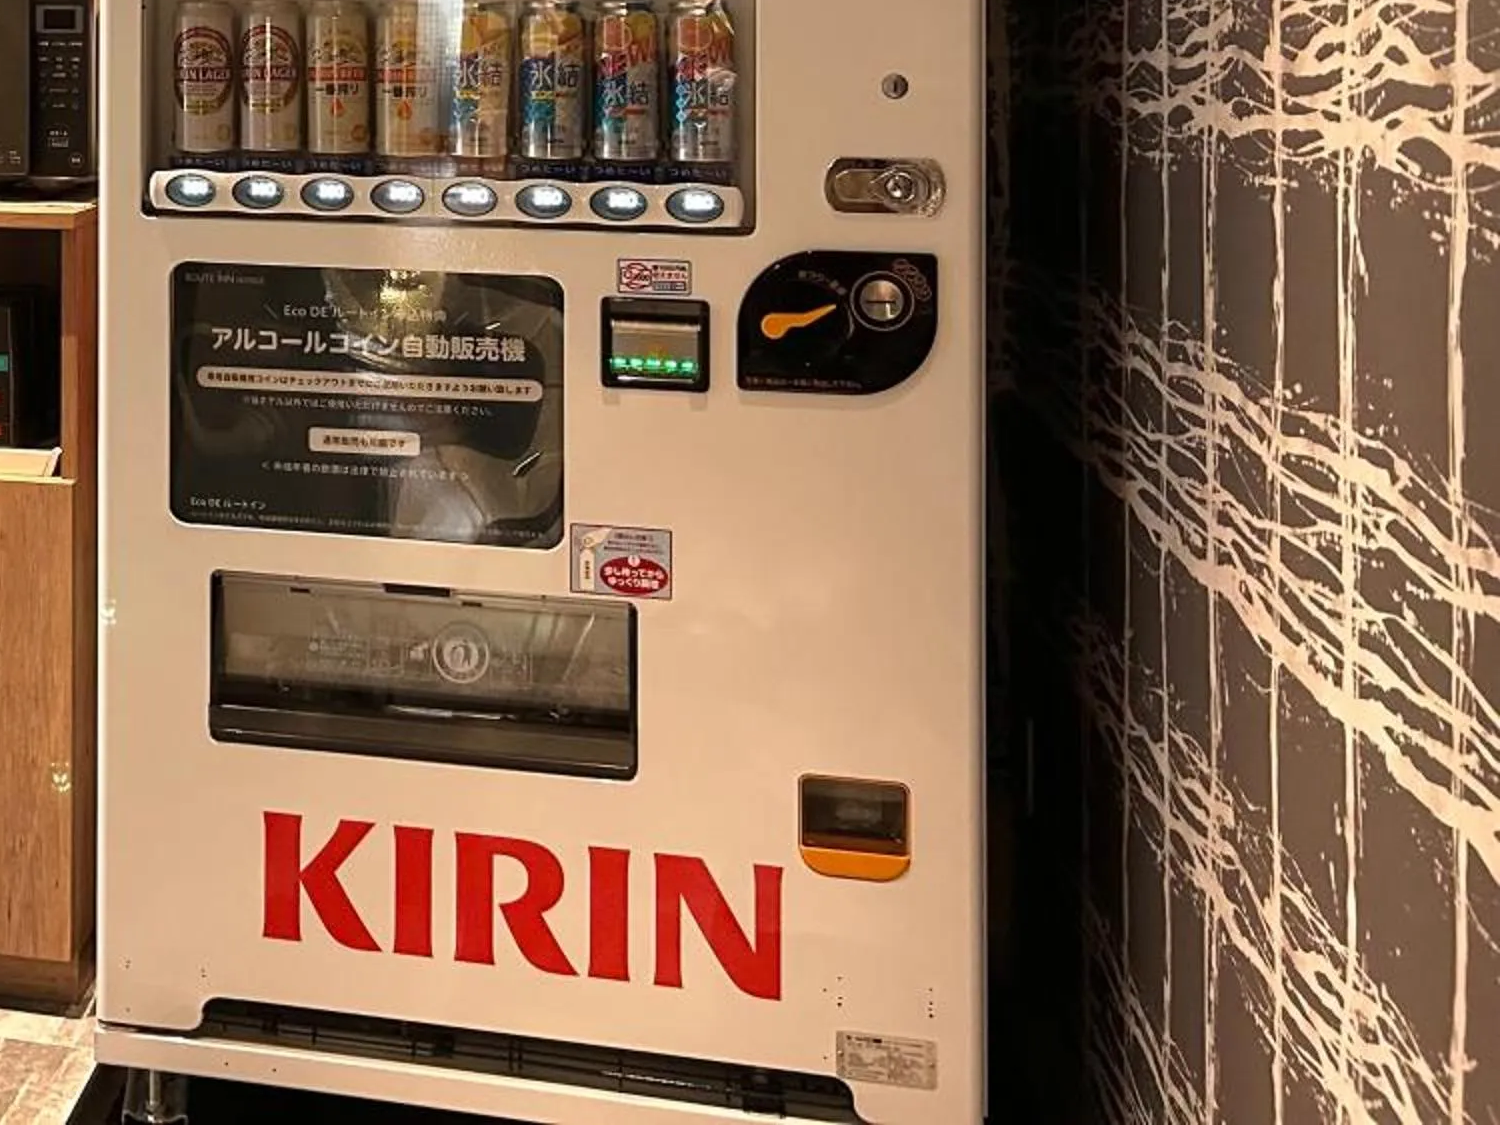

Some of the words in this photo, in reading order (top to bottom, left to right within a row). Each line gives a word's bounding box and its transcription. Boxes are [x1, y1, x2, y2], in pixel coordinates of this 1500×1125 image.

[529, 60, 581, 89] 氷結
[283, 304, 307, 317] Eco
[310, 306, 329, 318] DE
[211, 327, 526, 362] アルコールコイン自動販売機
[263, 810, 784, 1002] KIRIN
